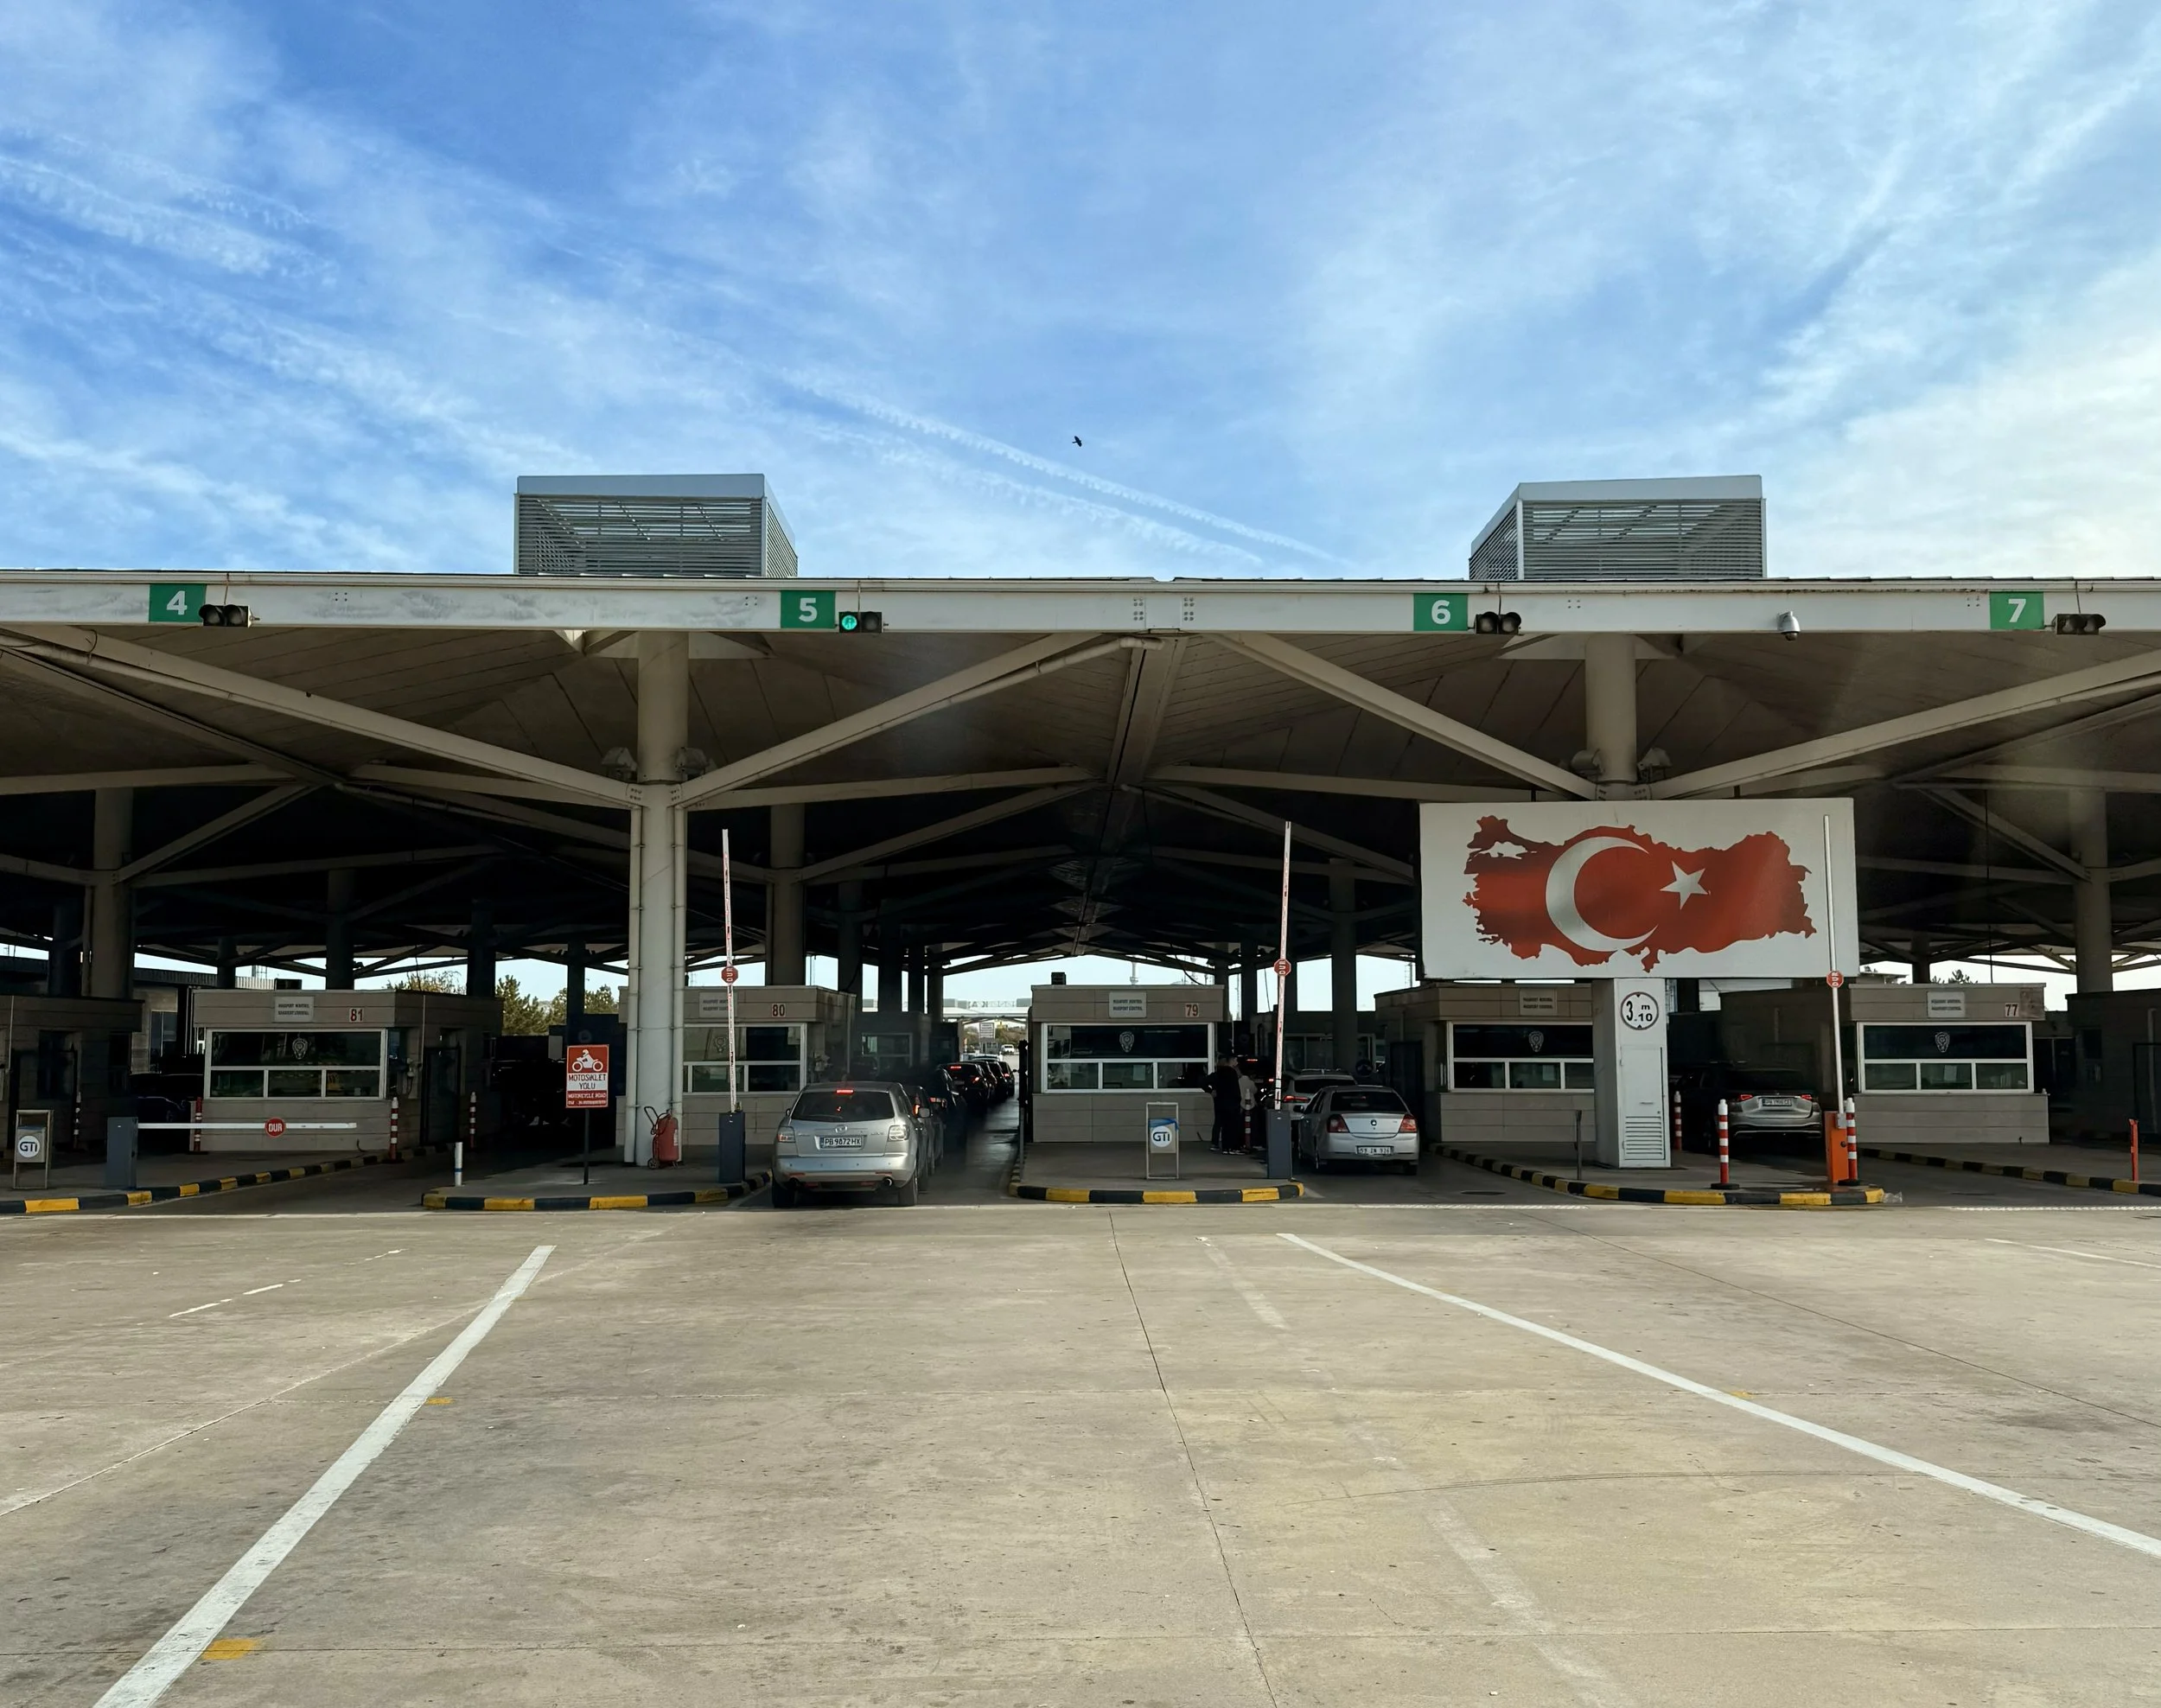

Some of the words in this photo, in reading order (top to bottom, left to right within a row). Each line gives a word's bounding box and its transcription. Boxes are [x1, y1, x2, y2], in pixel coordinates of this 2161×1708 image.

[167, 590, 188, 615] 4
[798, 597, 818, 622] 5
[1431, 599, 1450, 625] 6
[2008, 598, 2026, 622] 7
[350, 1009, 363, 1022] 81
[772, 1004, 785, 1017] 80
[1186, 1004, 1199, 1017] 79
[2005, 1004, 2018, 1017] 77
[268, 1123, 283, 1132] DUR
[1152, 1131, 1170, 1142] GTI
[20, 1141, 37, 1152] GTI
